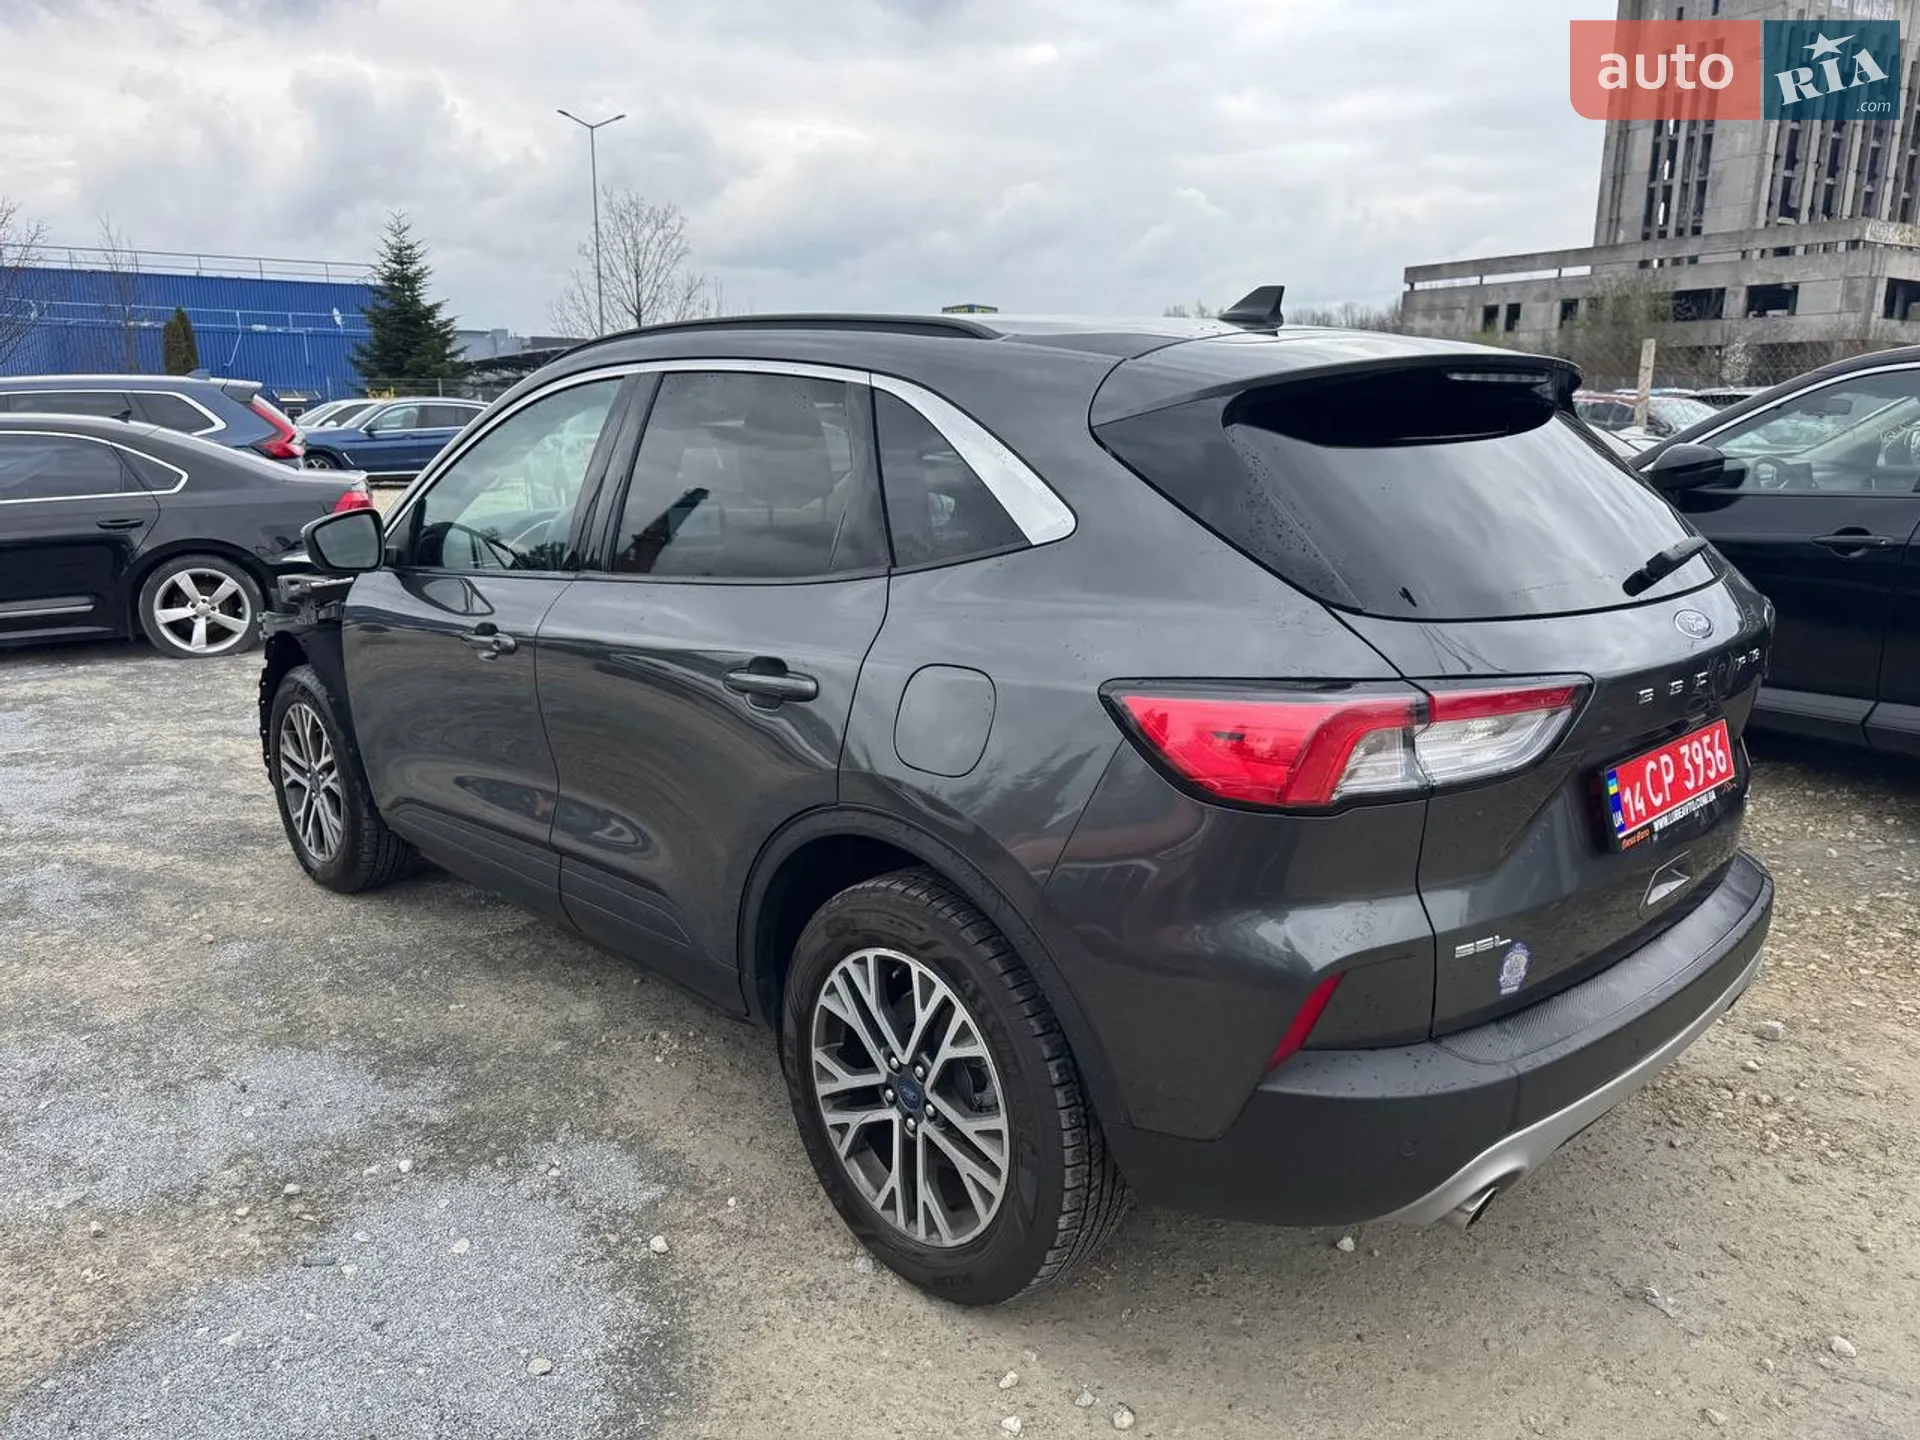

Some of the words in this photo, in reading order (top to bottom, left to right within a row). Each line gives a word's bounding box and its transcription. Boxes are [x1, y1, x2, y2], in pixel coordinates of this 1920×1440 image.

[1637, 648, 1760, 705] ESCPE
[1623, 781, 1646, 822] 14
[1645, 754, 1675, 807] CP
[1679, 729, 1727, 791] 3956
